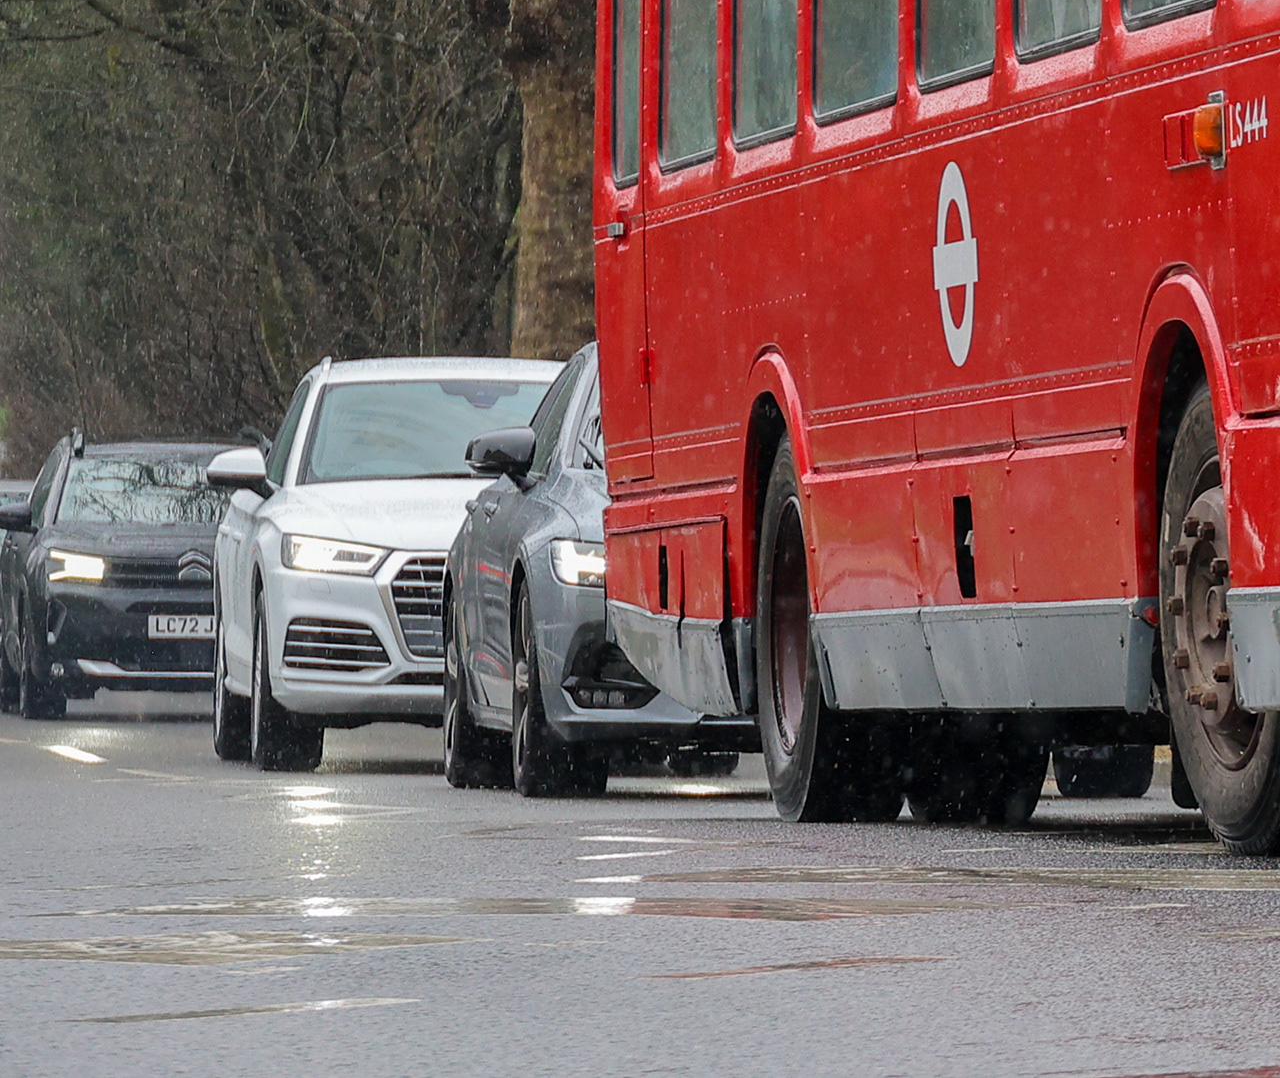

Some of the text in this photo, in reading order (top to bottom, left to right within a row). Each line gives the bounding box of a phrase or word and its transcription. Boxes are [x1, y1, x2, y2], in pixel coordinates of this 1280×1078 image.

[1228, 95, 1268, 148] LS444
[155, 616, 216, 633] LC72 J
